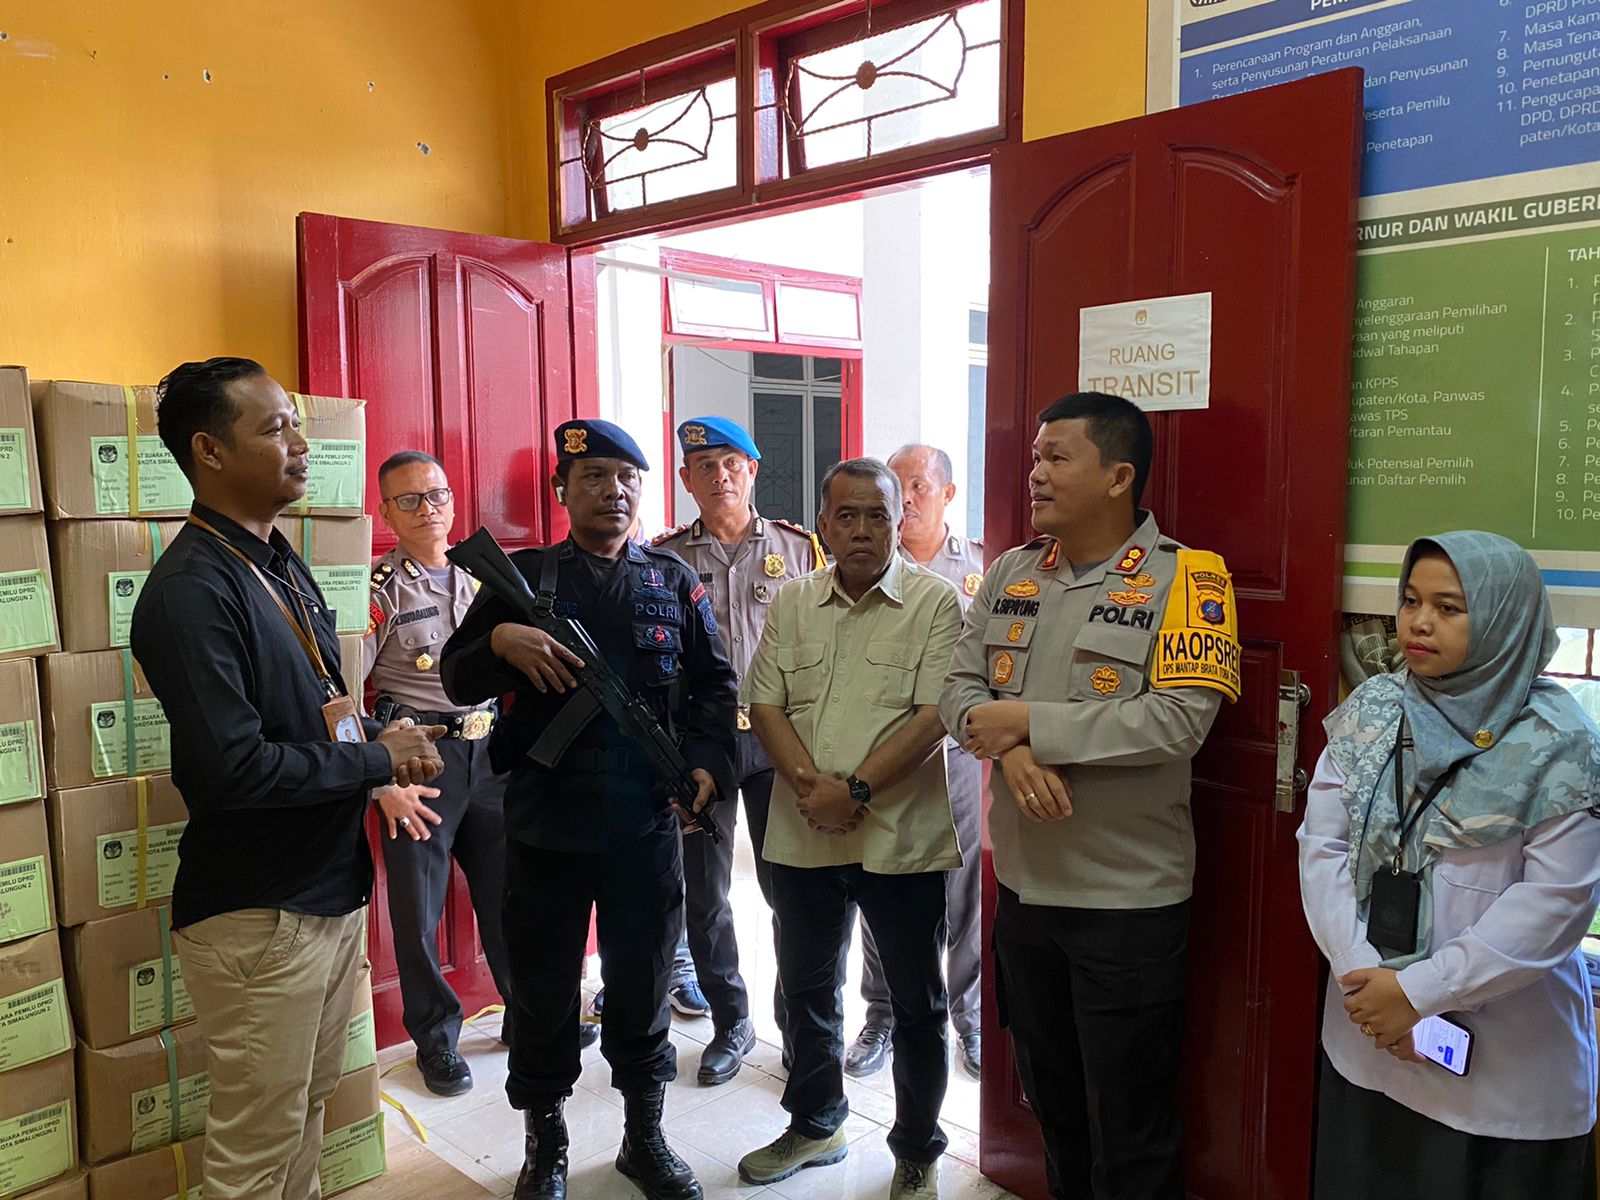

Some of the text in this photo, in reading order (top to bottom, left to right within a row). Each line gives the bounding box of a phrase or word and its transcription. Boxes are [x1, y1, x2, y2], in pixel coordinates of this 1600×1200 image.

[1525, 0, 1567, 19] DPRD
[1499, 11, 1600, 43] 7. Masa Kam
[1194, 17, 1423, 79] 1. Perencanaan Program dan Anggaran,
[1496, 30, 1600, 61] 8. Masa Tena
[1212, 77, 1239, 91] serta
[1241, 60, 1309, 84] Penyusunan
[1311, 47, 1370, 67] Peraturan
[1372, 27, 1452, 54] Pelaksanaan
[1496, 47, 1600, 79] 9. Pemungut
[1363, 75, 1387, 89] dan
[1389, 57, 1469, 83] Penyusunan
[1497, 66, 1600, 95] 10. Penetapan
[1363, 95, 1451, 122] eserta Pemilu
[1496, 99, 1517, 113] 11.
[1520, 109, 1556, 127] DPD,
[1519, 120, 1600, 147] paten/Kota
[1366, 132, 1433, 153] Penetapan
[1408, 214, 1449, 235] DAN
[1453, 205, 1518, 229] WAKIL
[1567, 246, 1600, 262] TAH
[1567, 277, 1578, 289] 1.
[1356, 296, 1414, 312] Anggaran
[1442, 303, 1507, 319] Pemilihan
[1564, 313, 1577, 326] 2.
[1380, 329, 1410, 343] yang
[1413, 322, 1465, 339] meliputi
[1108, 342, 1176, 366] RUANG
[1387, 343, 1439, 357] Tahapan
[1563, 348, 1576, 361] 3.
[1589, 364, 1600, 378] C
[1087, 369, 1201, 398] TRANSIT
[1365, 376, 1399, 389] KPPS
[1561, 382, 1600, 396] 4. P
[1433, 390, 1486, 402] Panwas
[1384, 408, 1409, 421] TPS
[1387, 425, 1452, 437] Pemantau
[1560, 420, 1572, 432] 5.
[1558, 438, 1571, 450] 6.
[1367, 457, 1424, 469] Potensial
[1426, 457, 1474, 469] Pemilih
[1558, 455, 1570, 467] 7.
[1377, 473, 1416, 486] Daftar
[1419, 473, 1466, 485] Pemilih
[1555, 472, 1569, 485] 8.
[1555, 490, 1568, 502] 9.
[1556, 508, 1577, 520] 10.
[635, 603, 679, 619] POLRI
[1088, 604, 1154, 630] POLRI
[1175, 661, 1199, 673] MANTAP
[14, 1004, 36, 1017] PEMILU
[14, 1128, 53, 1146] SIMALUNGUN
[21, 1125, 43, 1137] PEMILU
